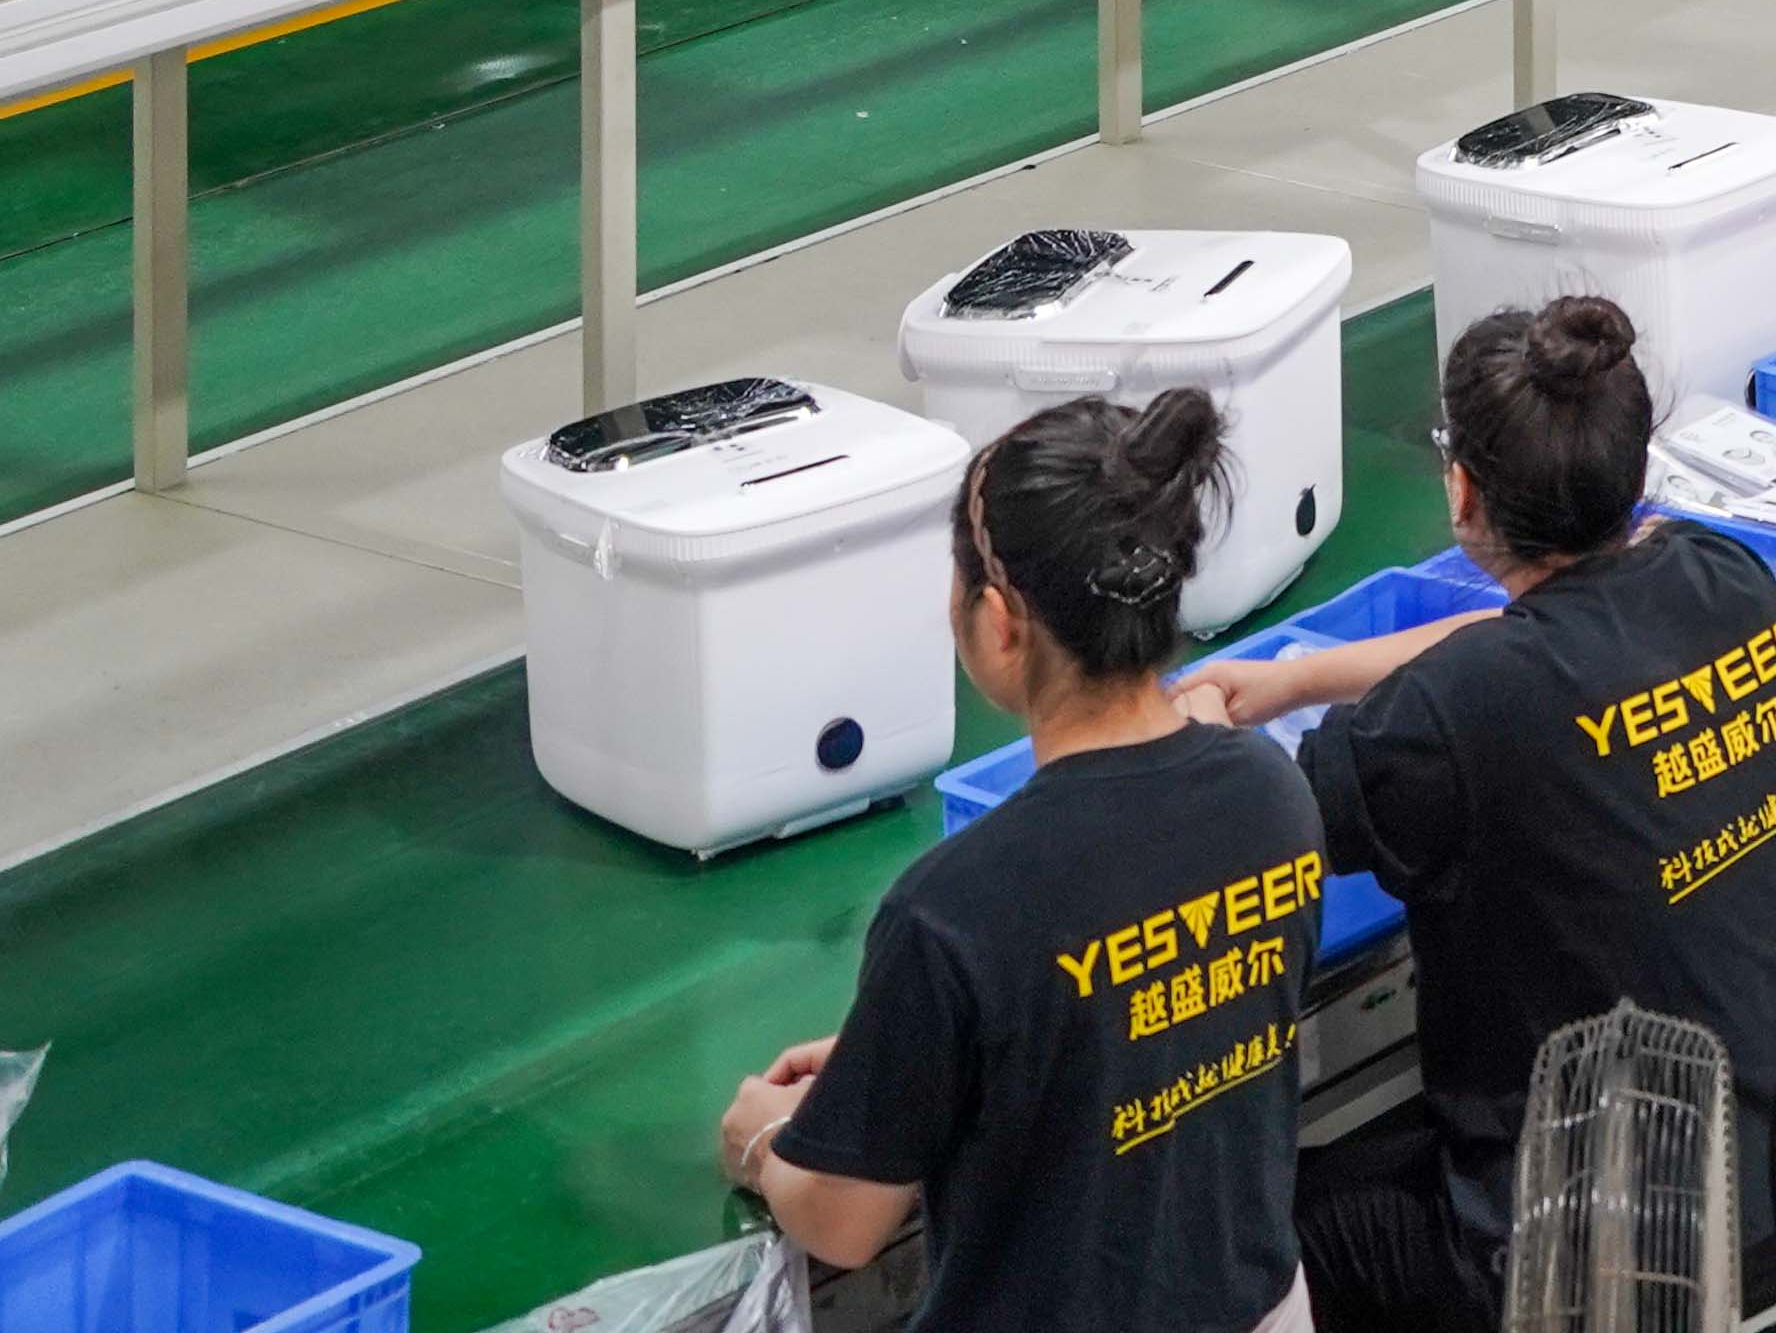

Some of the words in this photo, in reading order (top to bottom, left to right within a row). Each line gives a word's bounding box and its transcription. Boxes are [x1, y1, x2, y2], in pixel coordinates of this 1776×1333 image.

[1056, 848, 1324, 999] YESVEER
[1128, 935, 1287, 1042] 越盛威尔
